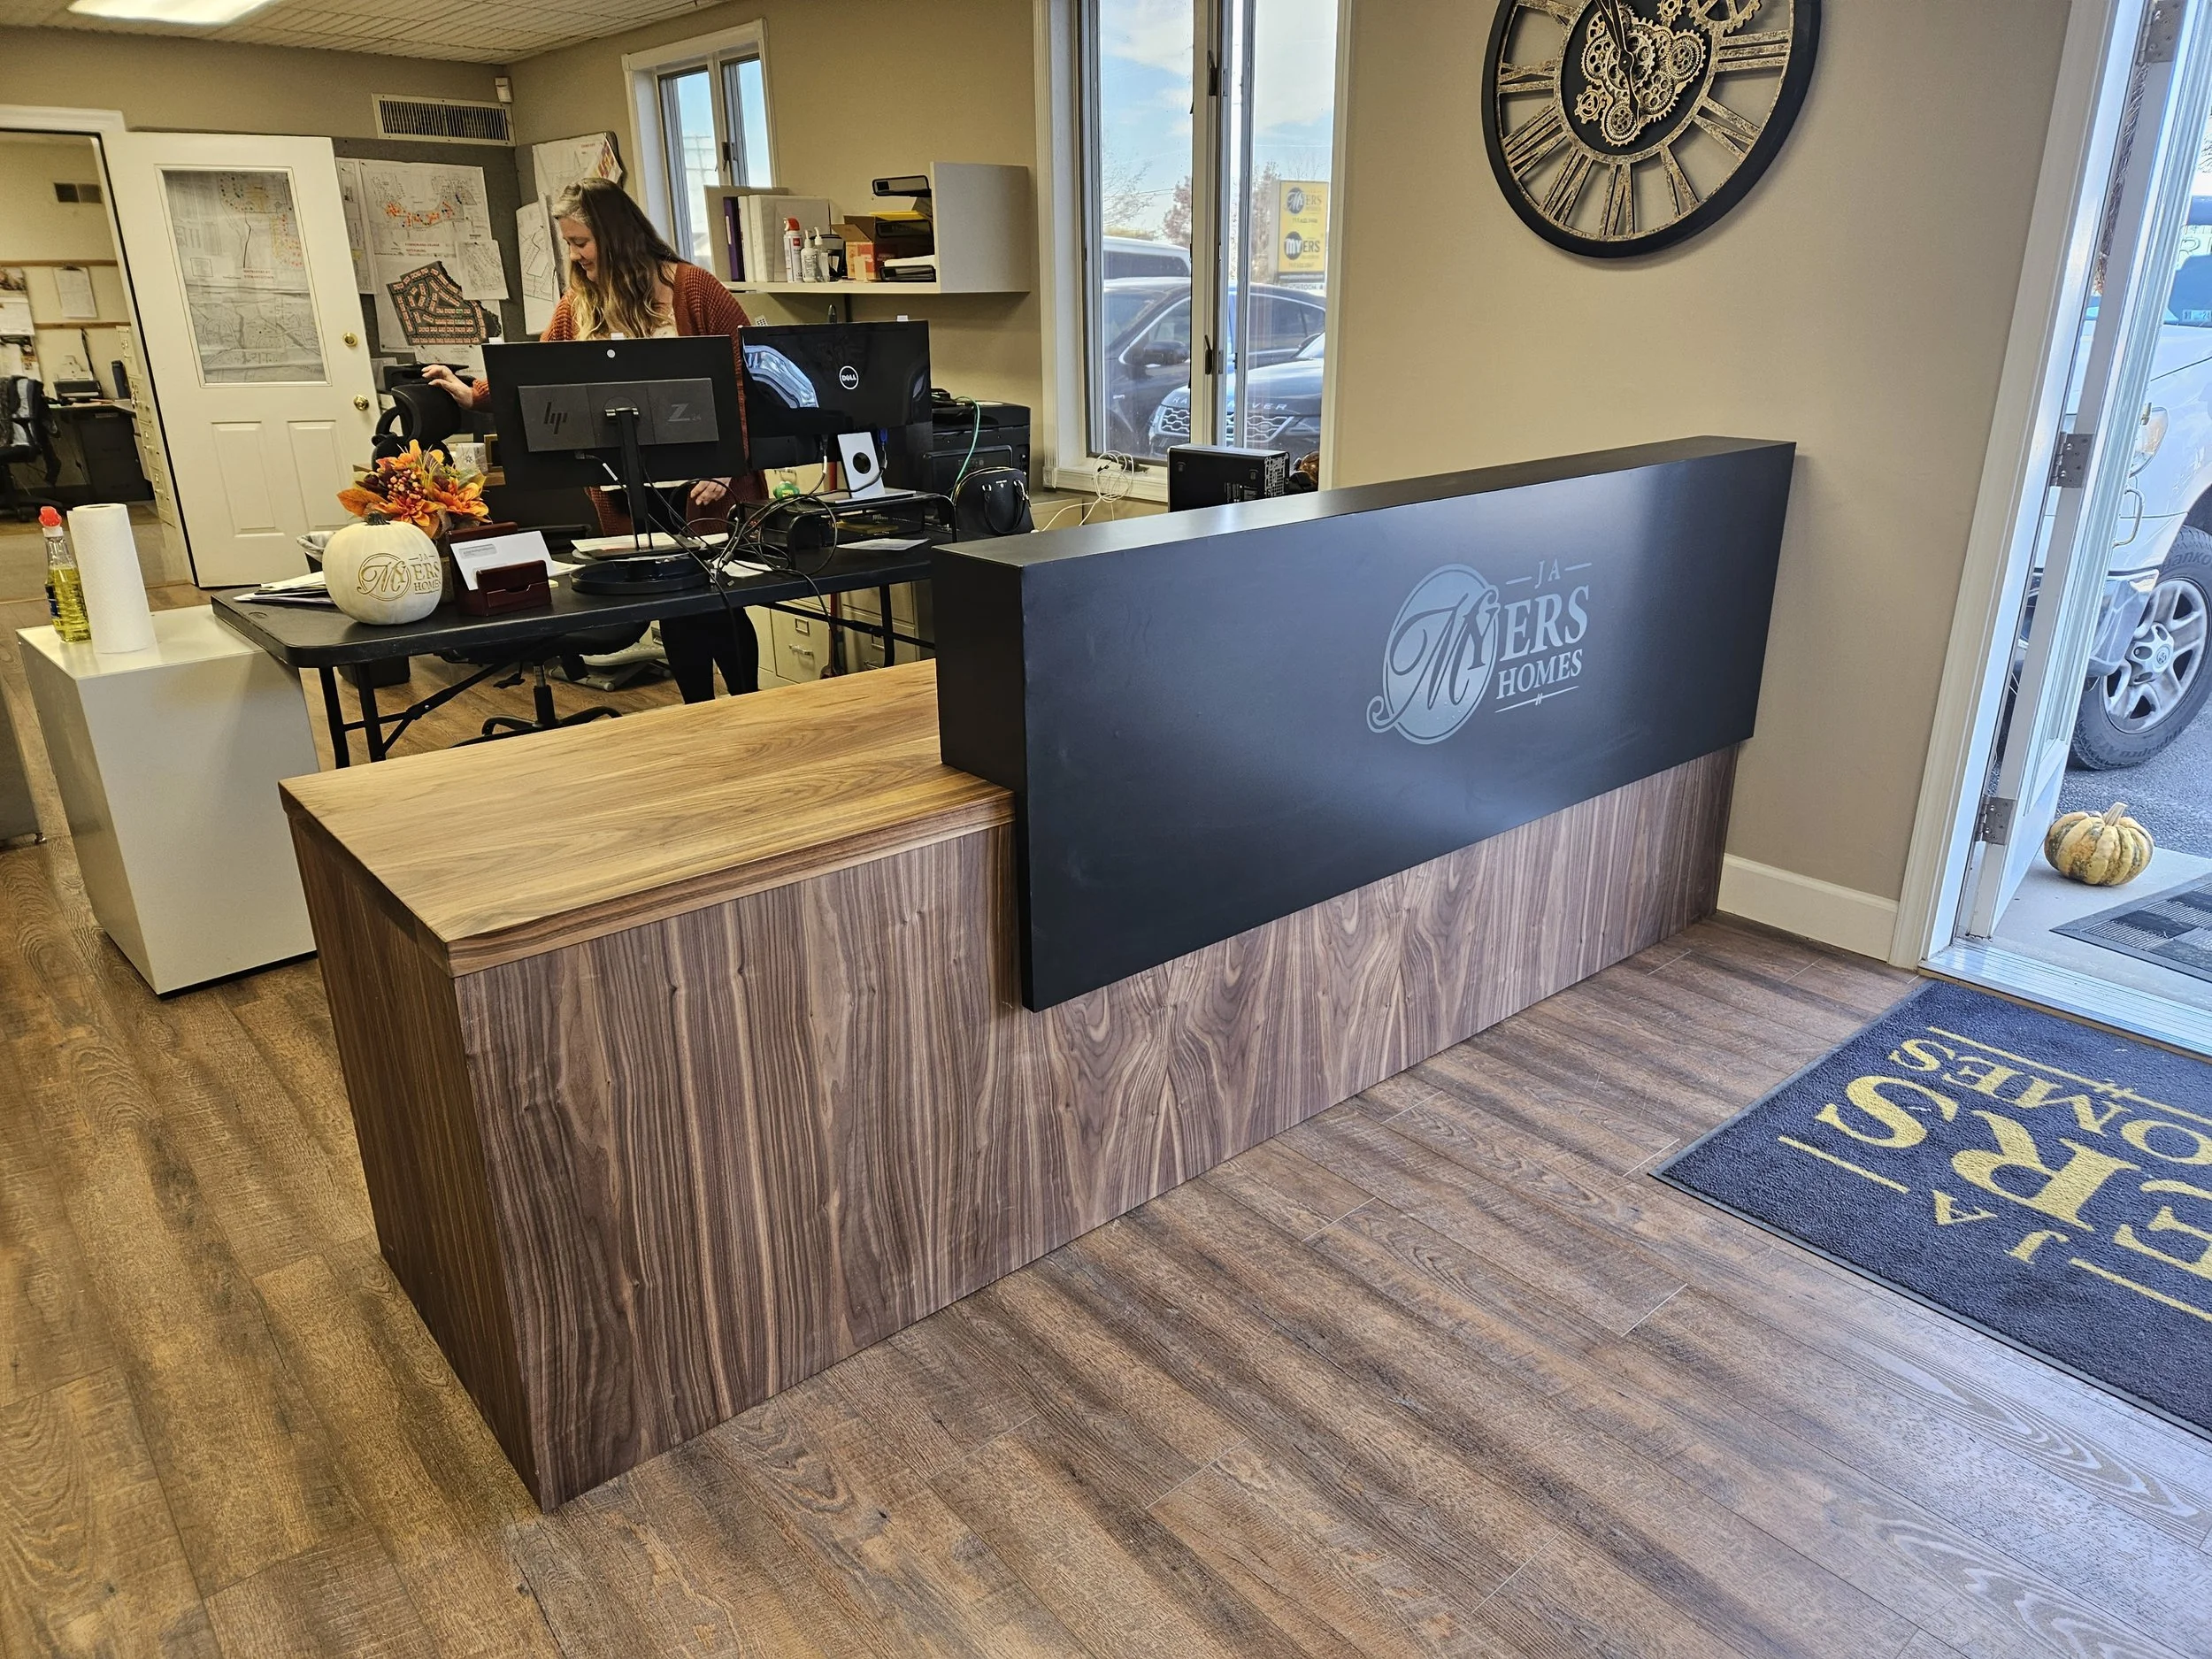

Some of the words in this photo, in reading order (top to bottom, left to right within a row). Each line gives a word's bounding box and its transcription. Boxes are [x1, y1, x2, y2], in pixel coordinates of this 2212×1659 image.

[543, 402, 567, 434] hp
[1227, 400, 1287, 411] RVER
[357, 560, 440, 595] MYERS
[1367, 585, 1589, 733] MYERS
[1495, 649, 1583, 700] HOMES
